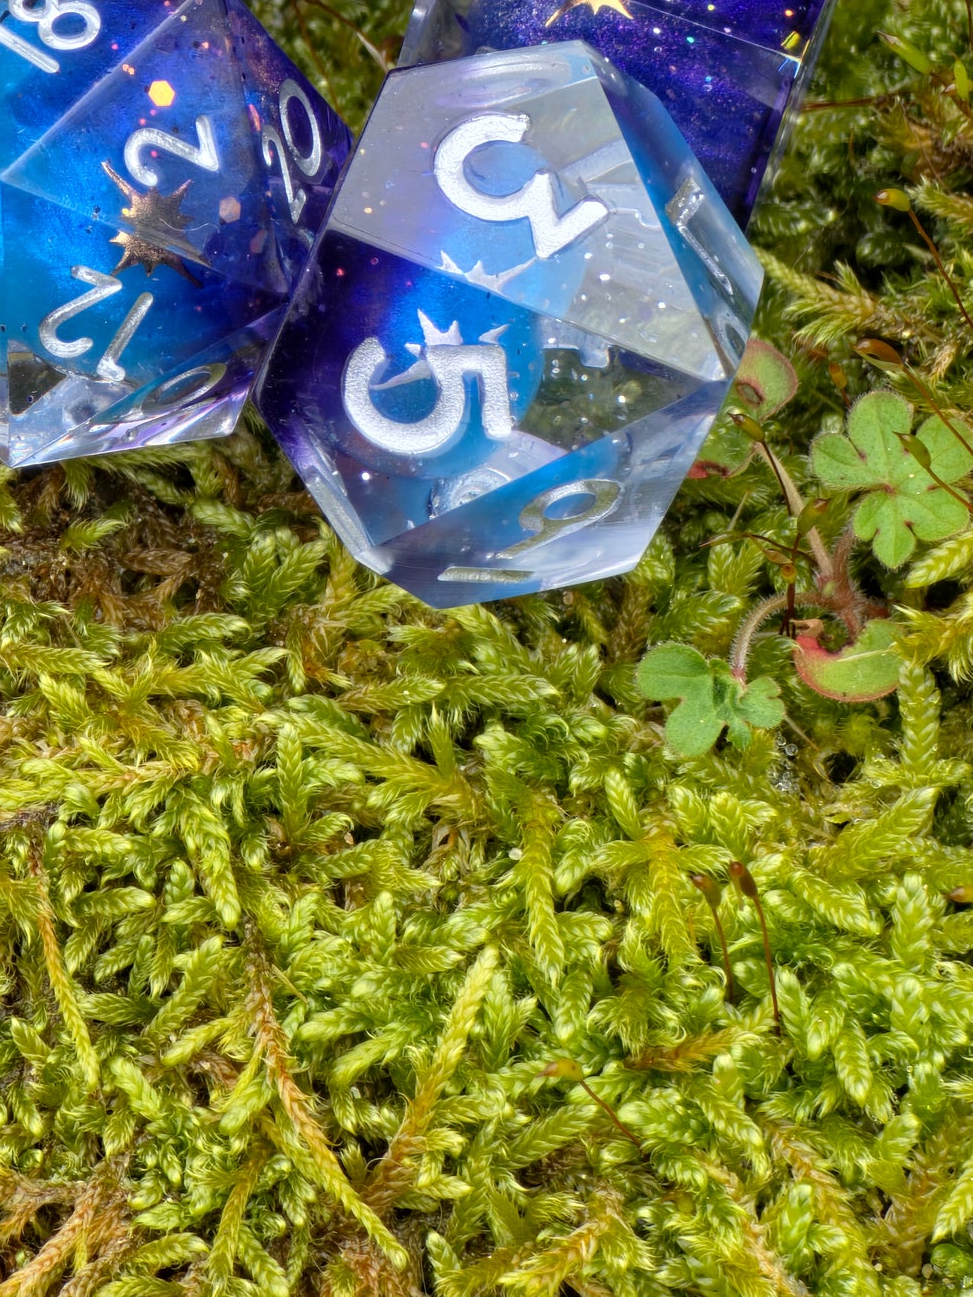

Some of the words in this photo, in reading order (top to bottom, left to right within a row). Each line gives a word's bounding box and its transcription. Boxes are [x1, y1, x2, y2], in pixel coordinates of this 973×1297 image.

[124, 115, 219, 187] 2
[262, 78, 322, 224] 20
[434, 111, 610, 259] 3
[39, 265, 154, 383] 12
[341, 336, 514, 456] 5
